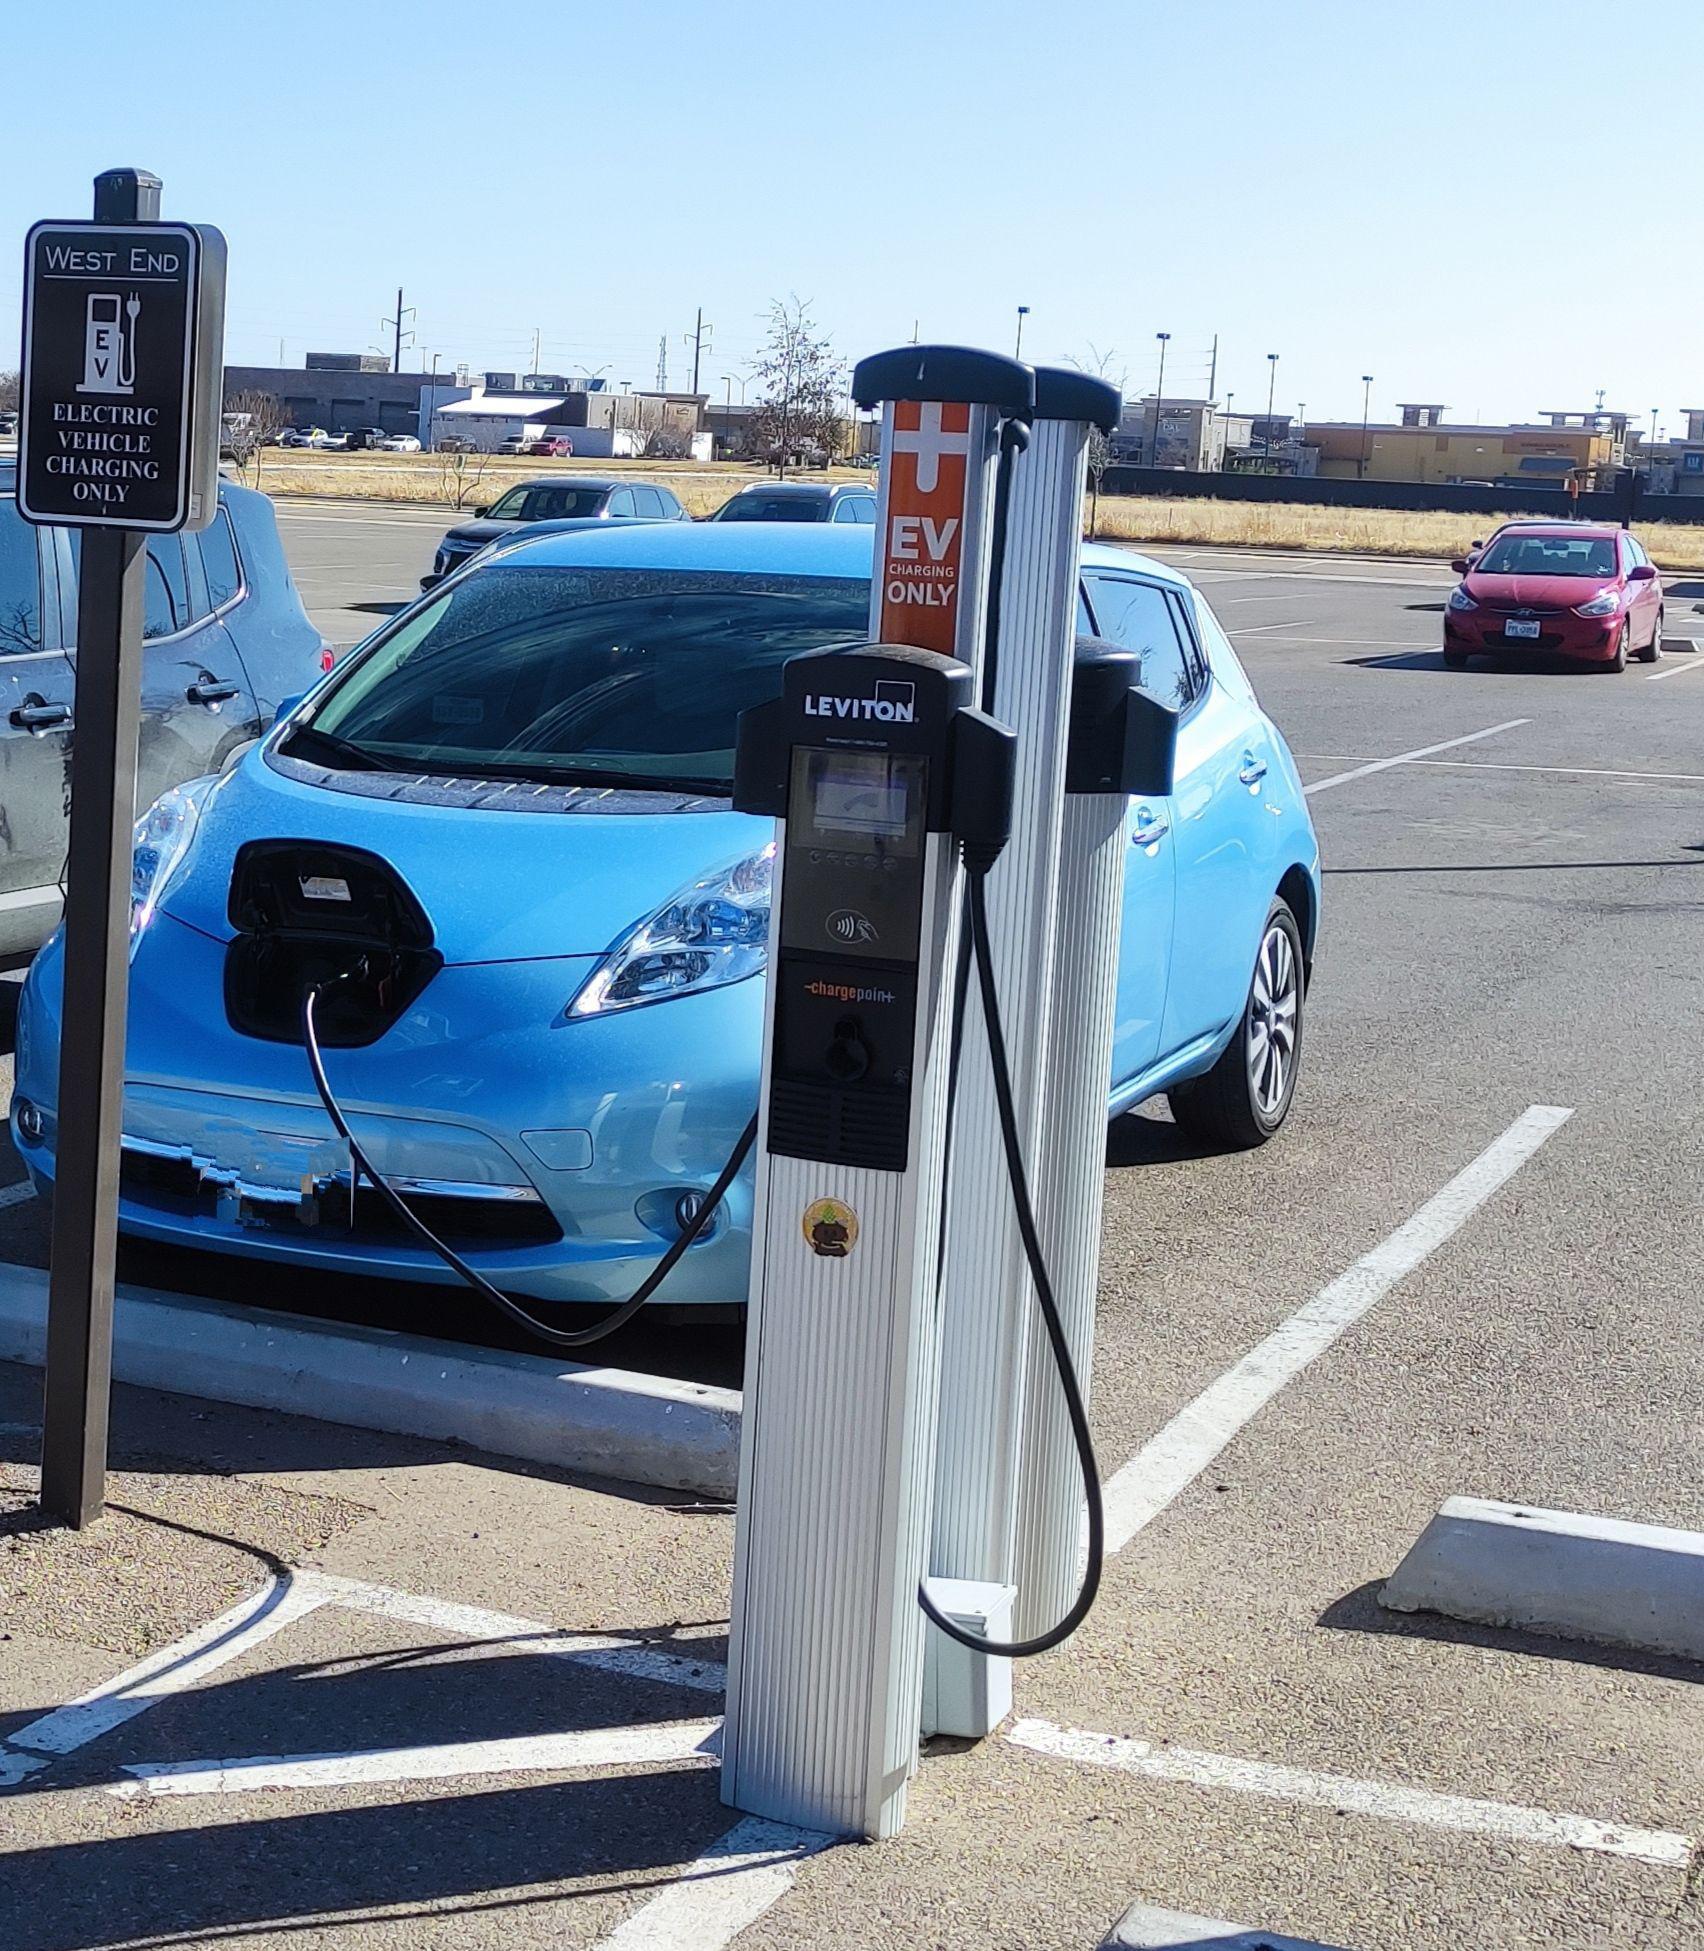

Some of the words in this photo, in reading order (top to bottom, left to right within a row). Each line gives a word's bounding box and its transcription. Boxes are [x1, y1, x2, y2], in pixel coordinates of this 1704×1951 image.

[46, 246, 116, 271] WEST
[130, 248, 179, 272] END
[53, 403, 158, 426] ELECTRIC
[58, 431, 151, 453] VEHICLE
[46, 456, 159, 479] CHARGING
[72, 482, 129, 502] ONLY
[891, 515, 959, 561] EV
[890, 563, 954, 577] CHARGING
[887, 581, 955, 606] ONLY
[804, 694, 915, 723] LEVITON
